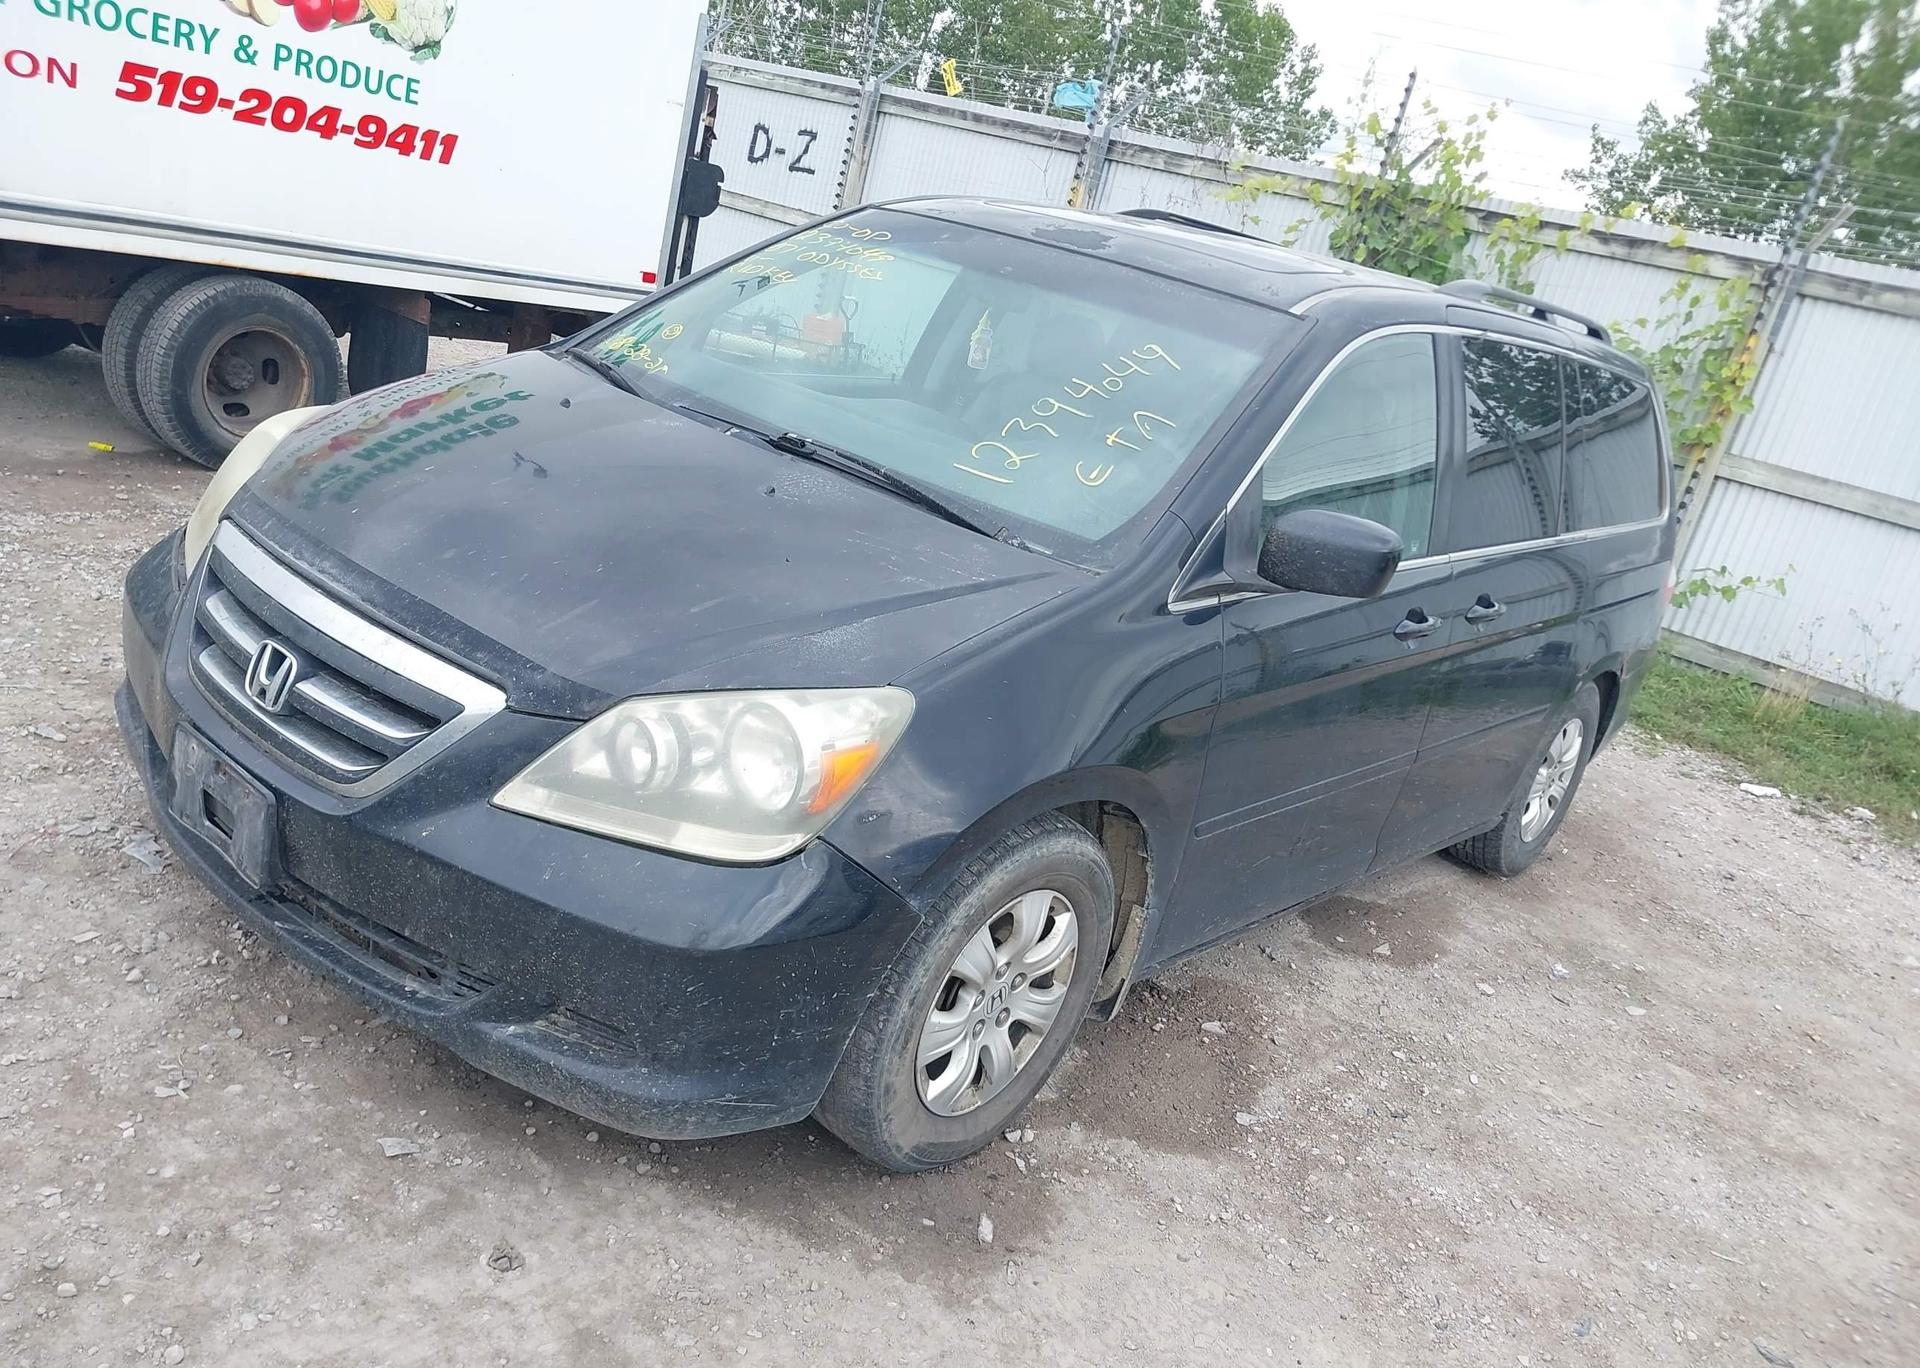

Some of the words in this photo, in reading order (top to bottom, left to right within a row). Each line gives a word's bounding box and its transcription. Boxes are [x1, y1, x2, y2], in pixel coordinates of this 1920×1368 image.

[4, 49, 77, 89] ON
[115, 61, 459, 165] 519-204-9411
[33, 0, 220, 55] GROCERY
[234, 34, 259, 66] &
[273, 43, 421, 106] PRODUCE
[747, 122, 818, 176] D-Z
[953, 344, 1182, 484] 12394049
